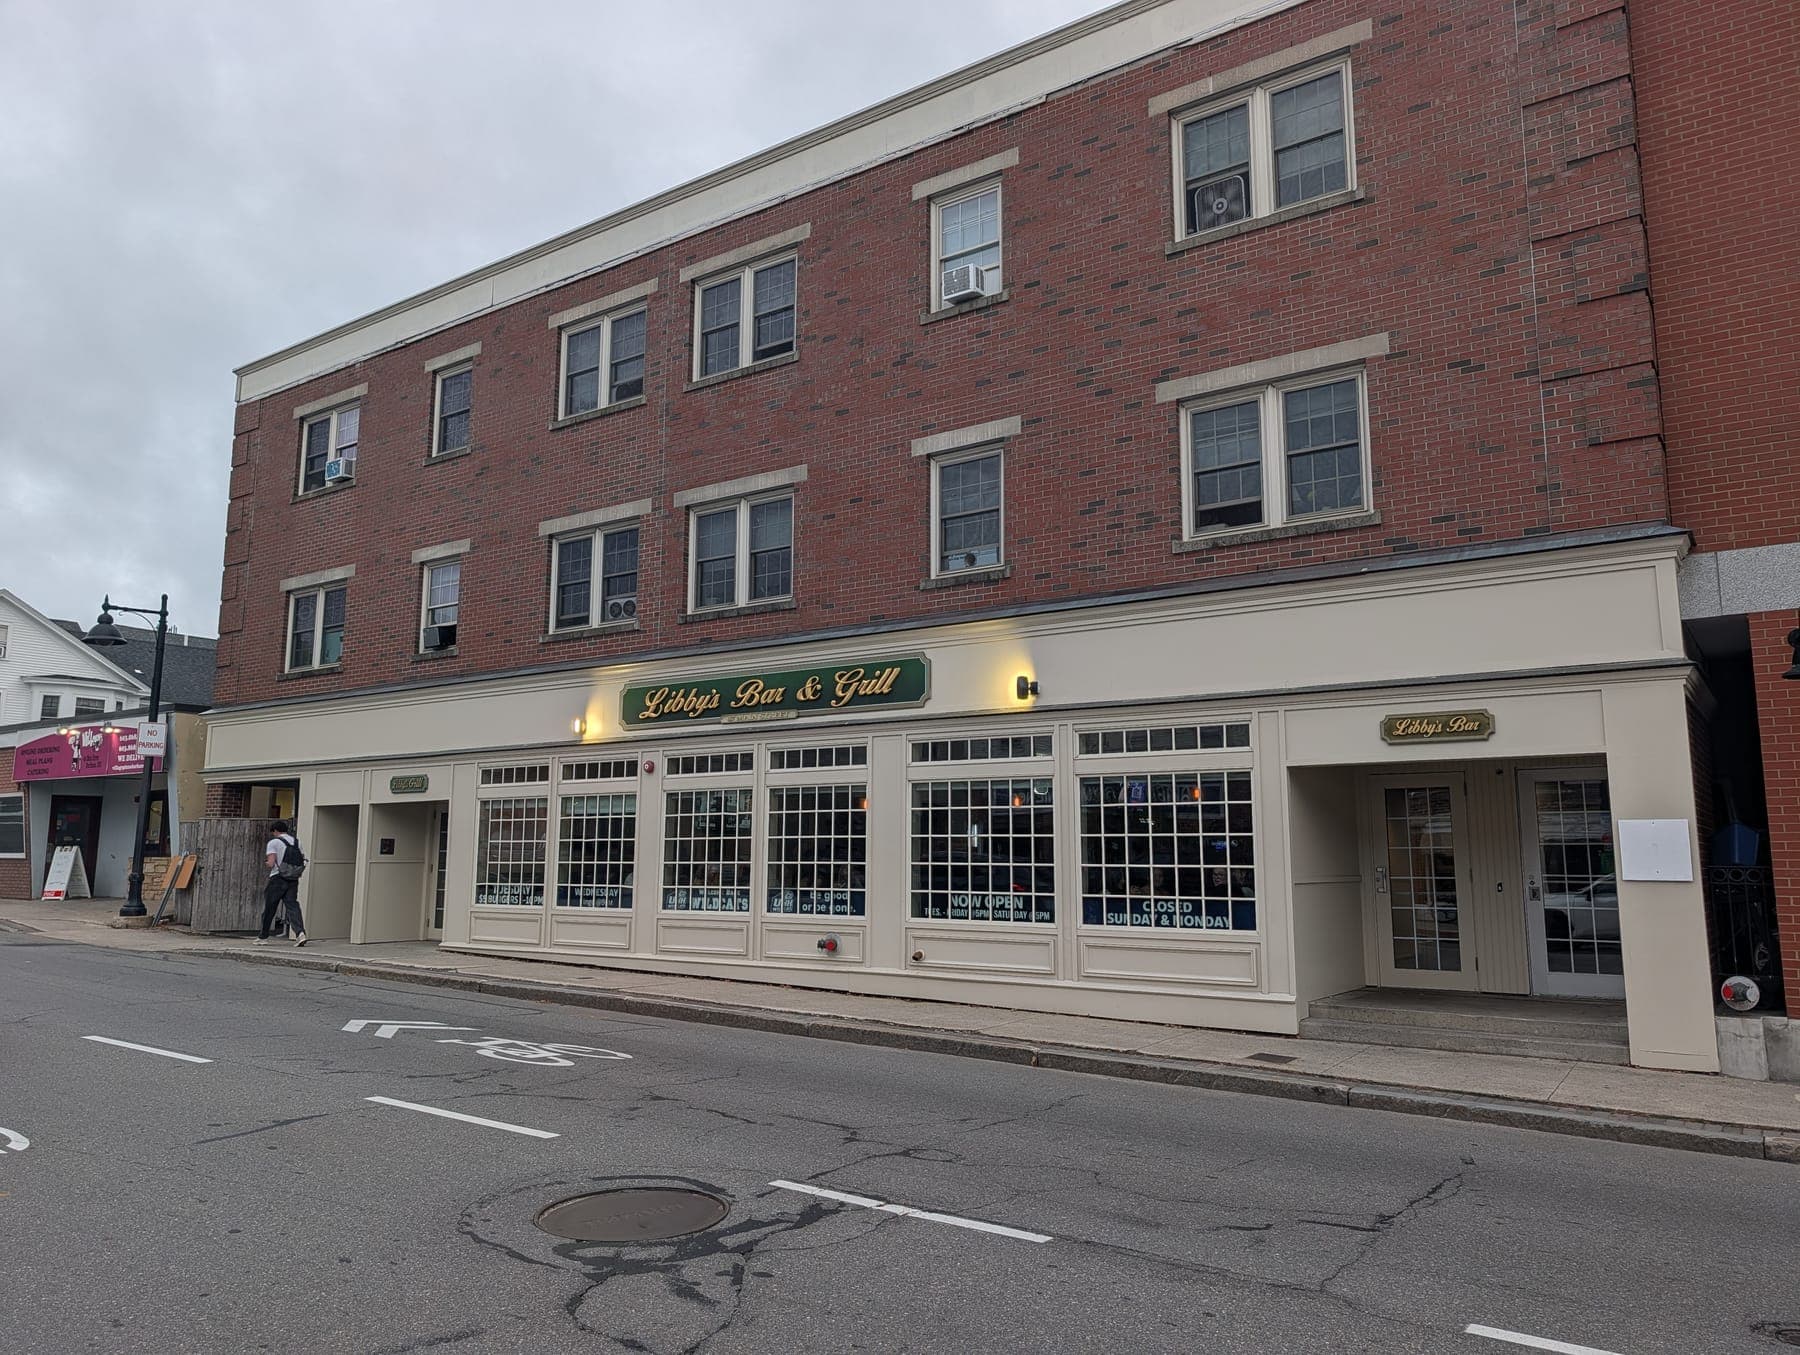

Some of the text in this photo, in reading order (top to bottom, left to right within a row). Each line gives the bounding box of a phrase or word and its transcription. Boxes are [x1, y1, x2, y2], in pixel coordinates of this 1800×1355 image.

[638, 667, 901, 719] Libby's Bar & Grill
[1392, 715, 1480, 738] Libby's Bar
[138, 741, 163, 749] PARKING
[823, 892, 849, 902] god
[950, 895, 1024, 910] NOW OPEN
[924, 907, 941, 916] TES.
[993, 910, 1028, 919] SATUDAY
[1142, 901, 1193, 913] COSED
[1160, 914, 1170, 926] &
